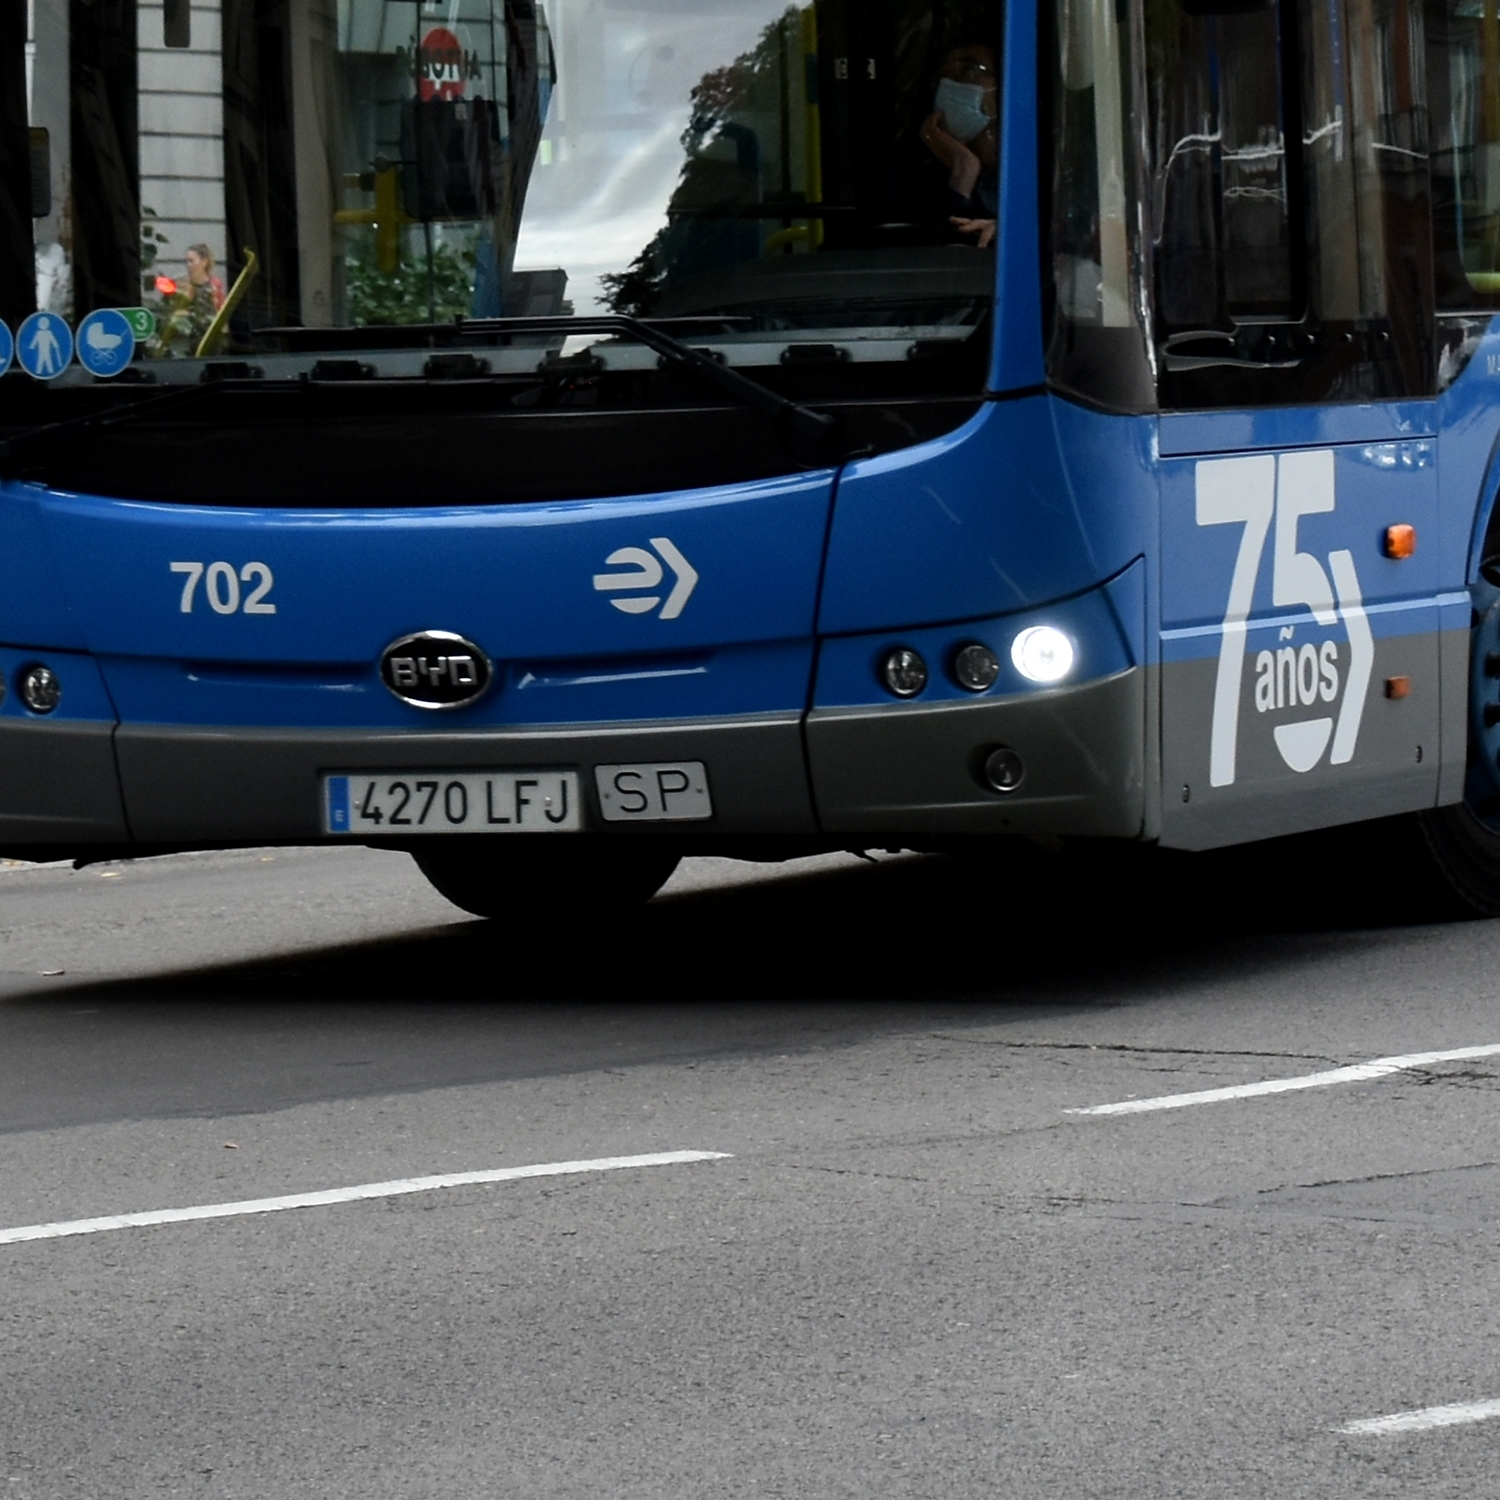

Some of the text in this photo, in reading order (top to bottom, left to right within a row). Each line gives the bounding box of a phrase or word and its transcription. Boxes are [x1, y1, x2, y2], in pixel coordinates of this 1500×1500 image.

[135, 312, 148, 331] 3
[170, 561, 276, 615] 702
[390, 657, 479, 686] BYD
[1255, 625, 1338, 713] años
[360, 779, 568, 825] 4270 LFJ
